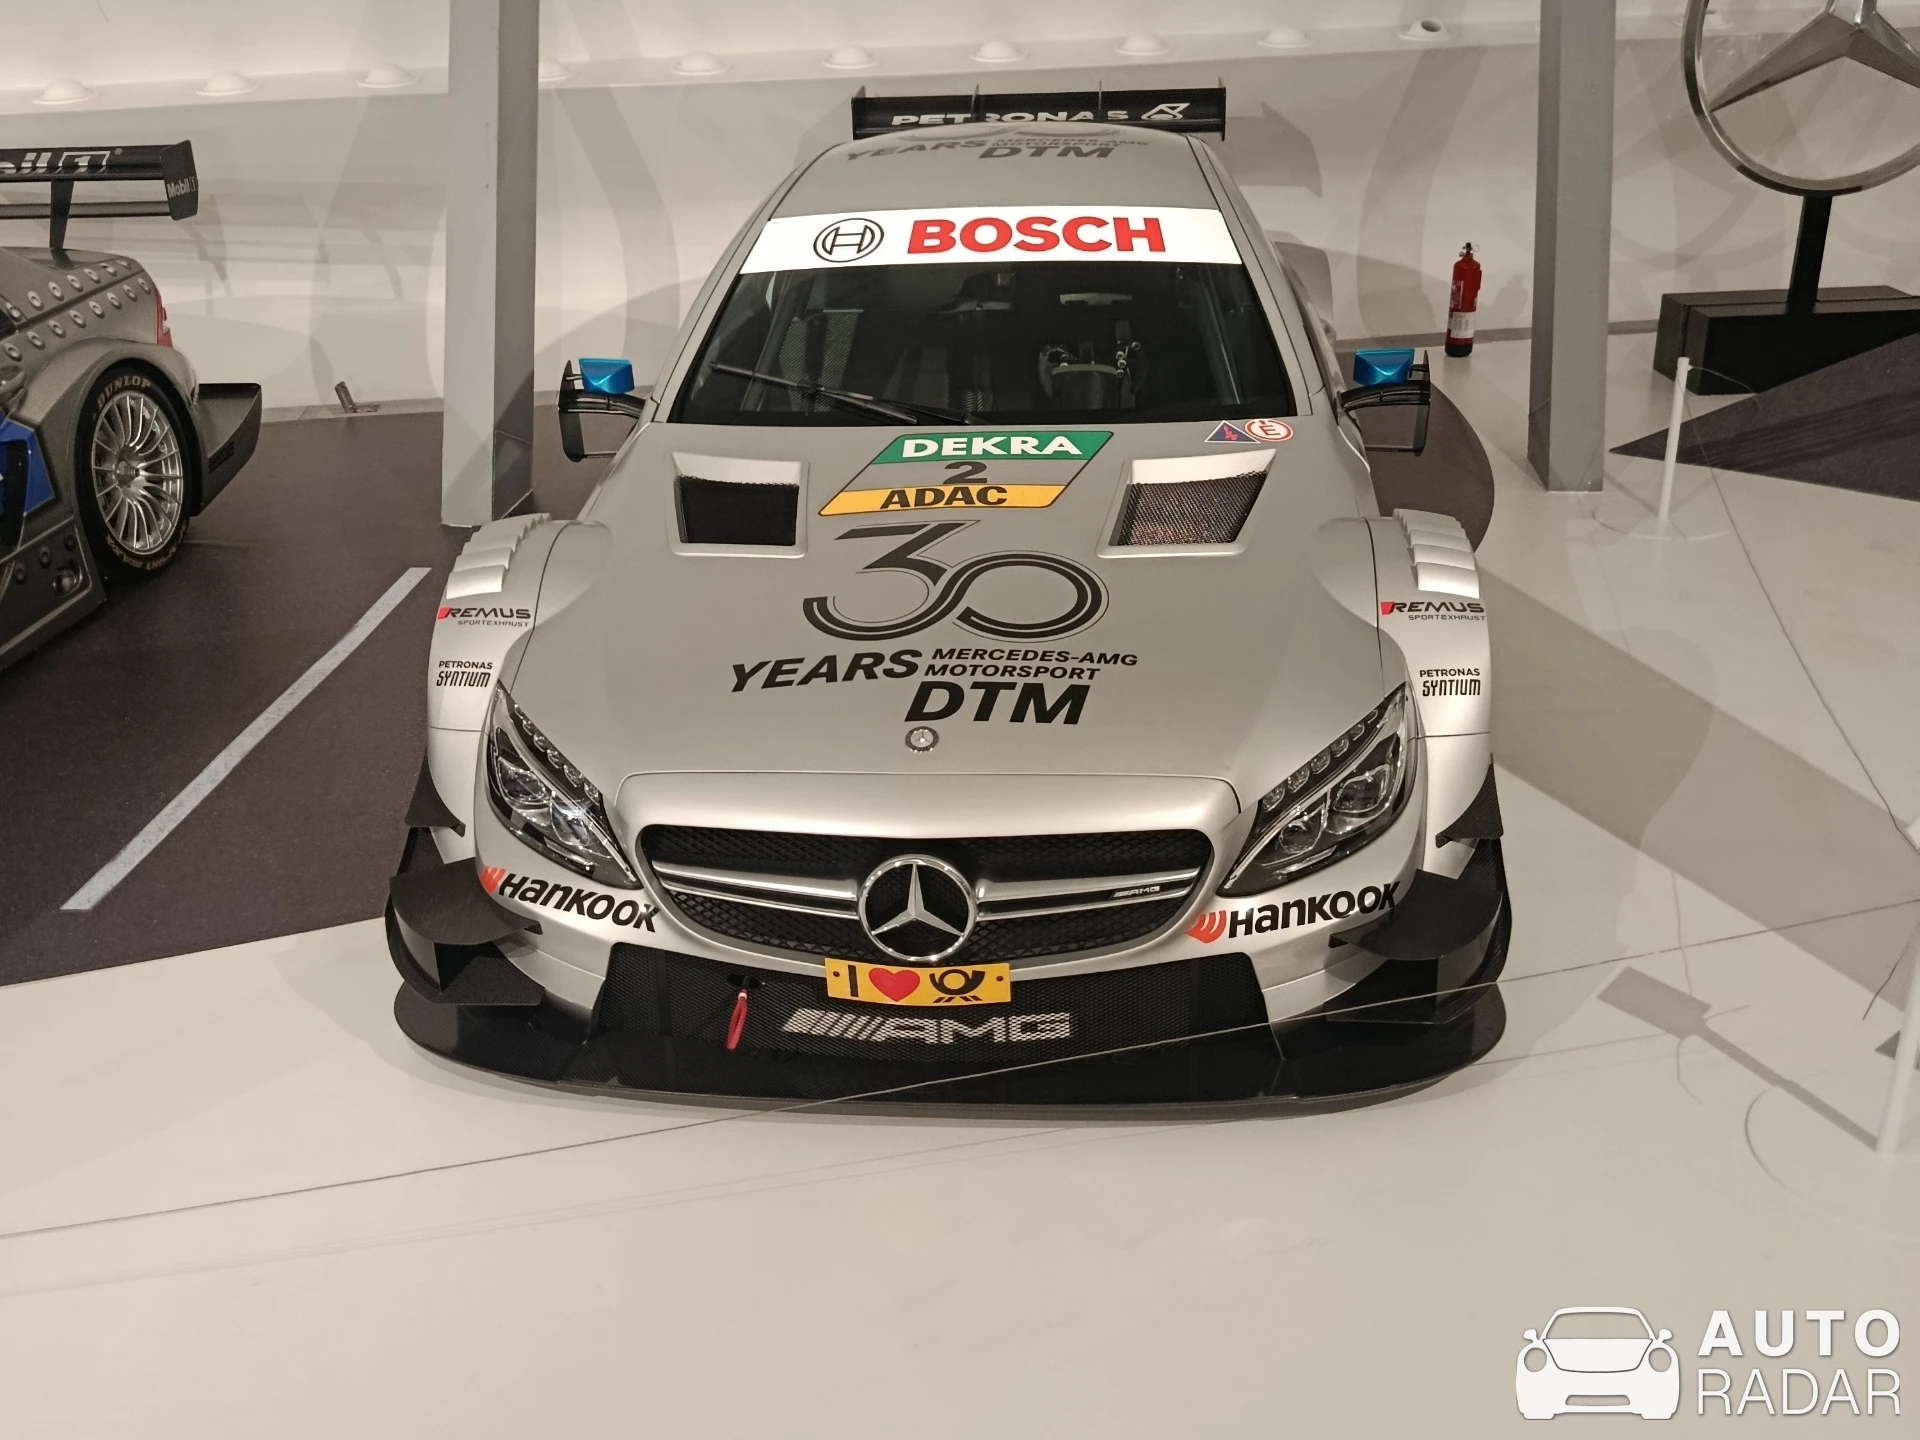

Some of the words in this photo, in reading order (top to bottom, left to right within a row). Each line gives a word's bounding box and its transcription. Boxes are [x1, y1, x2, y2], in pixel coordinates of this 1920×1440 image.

[848, 140, 988, 160] YEARS
[979, 146, 1117, 159] DTM
[907, 216, 1166, 254] BOSCH
[97, 375, 151, 410] DUNLOP
[901, 435, 1083, 459] DEKRA
[942, 461, 988, 485] 2
[880, 486, 1007, 509] ADAC
[803, 520, 1109, 643] 30
[444, 607, 531, 619] REMUS
[1389, 602, 1485, 613] REMUS
[438, 660, 493, 669] PETRONAS
[931, 648, 1138, 666] MERCEDES-AMG
[436, 671, 491, 687] SYNTIUM
[731, 649, 922, 693] YEARS
[924, 664, 1101, 681] MOTORSPORT
[1420, 668, 1480, 677] PETRONAS
[1422, 679, 1481, 697] SYNTIUM
[904, 681, 1091, 725] DTM
[870, 1012, 1071, 1044] AMG
